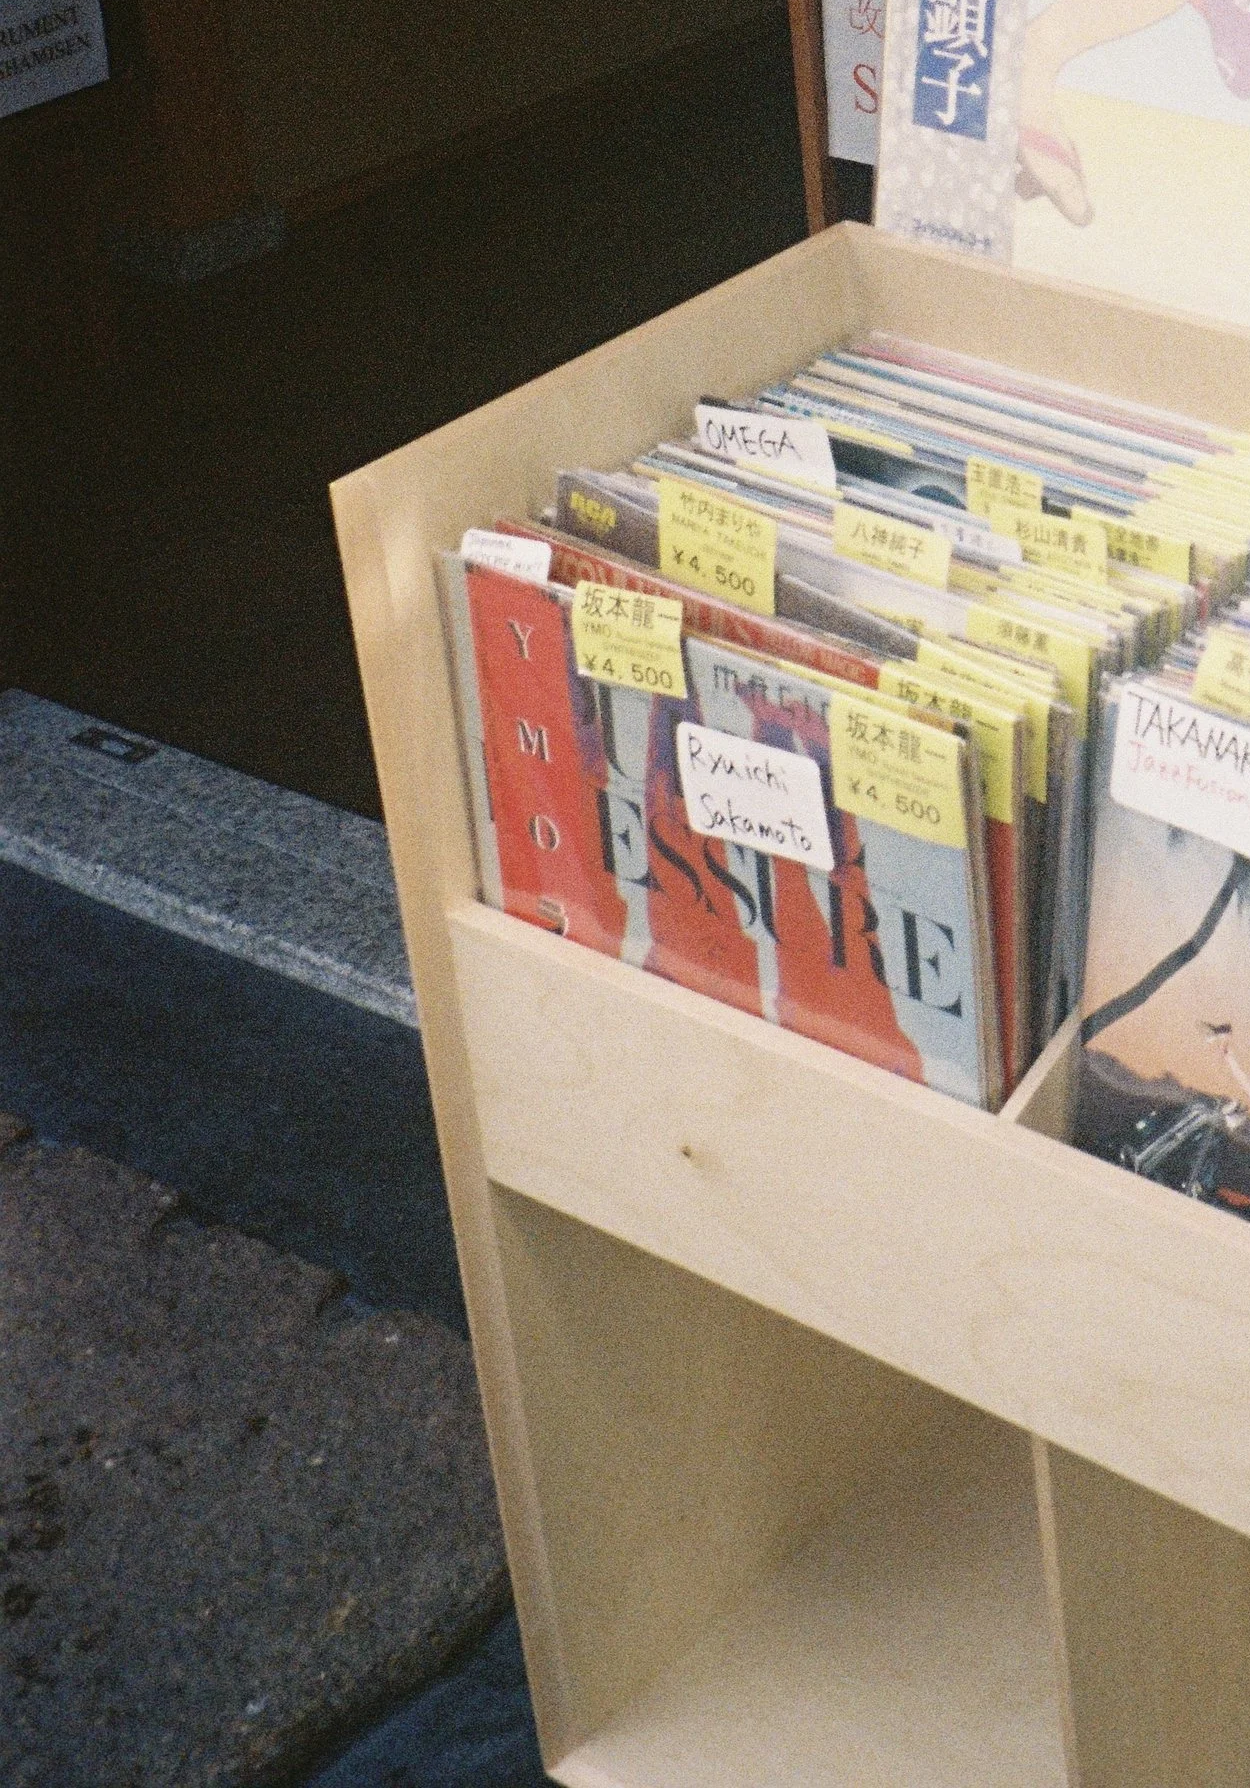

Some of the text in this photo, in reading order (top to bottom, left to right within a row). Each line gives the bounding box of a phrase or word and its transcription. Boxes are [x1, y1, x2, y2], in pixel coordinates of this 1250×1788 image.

[705, 419, 803, 462] OMEGA
[581, 585, 680, 630] 坂本龍一
[687, 731, 789, 796] Ryuichi
[845, 710, 947, 766] 坂本龍一
[700, 791, 813, 852] Sakamoto
